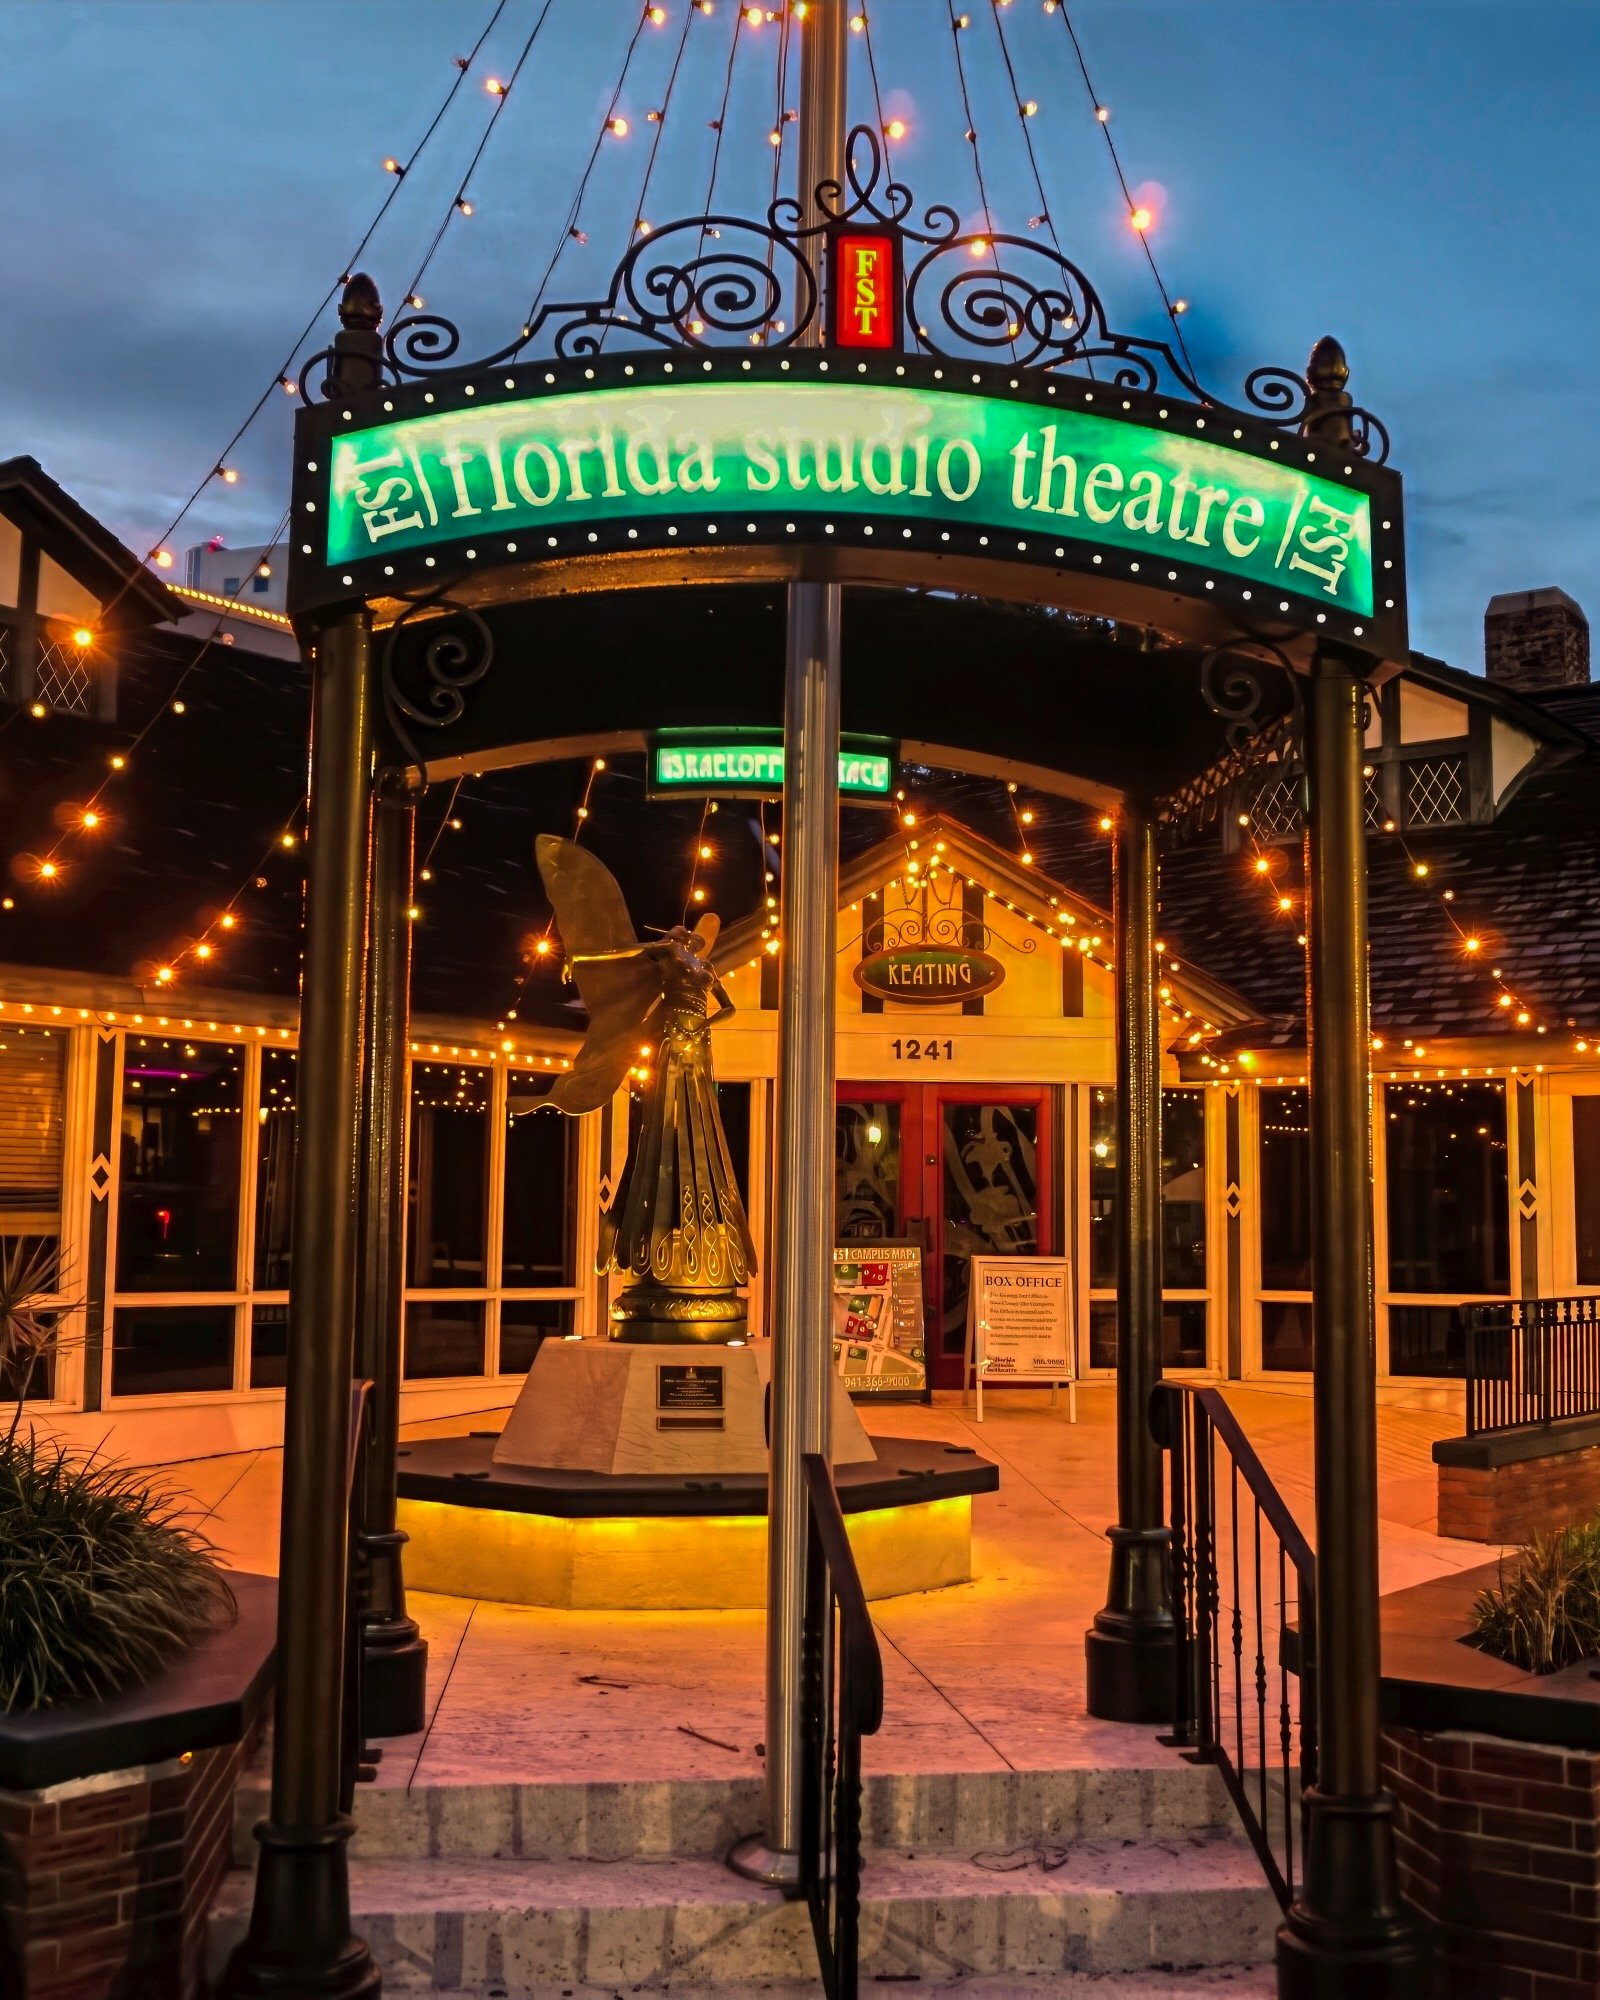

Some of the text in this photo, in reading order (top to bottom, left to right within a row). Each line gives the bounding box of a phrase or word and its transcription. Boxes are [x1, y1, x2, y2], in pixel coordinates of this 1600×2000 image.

[854, 249, 878, 335] FST
[334, 444, 424, 543] FST
[440, 404, 1265, 558] florida studio theatre
[1289, 494, 1366, 596] FST
[888, 963, 971, 986] KEATING
[892, 1039, 953, 1060] 1241
[851, 1248, 890, 1261] CAMPUS
[892, 1248, 913, 1260] MAP
[985, 1275, 1062, 1288] BOX OFFICE
